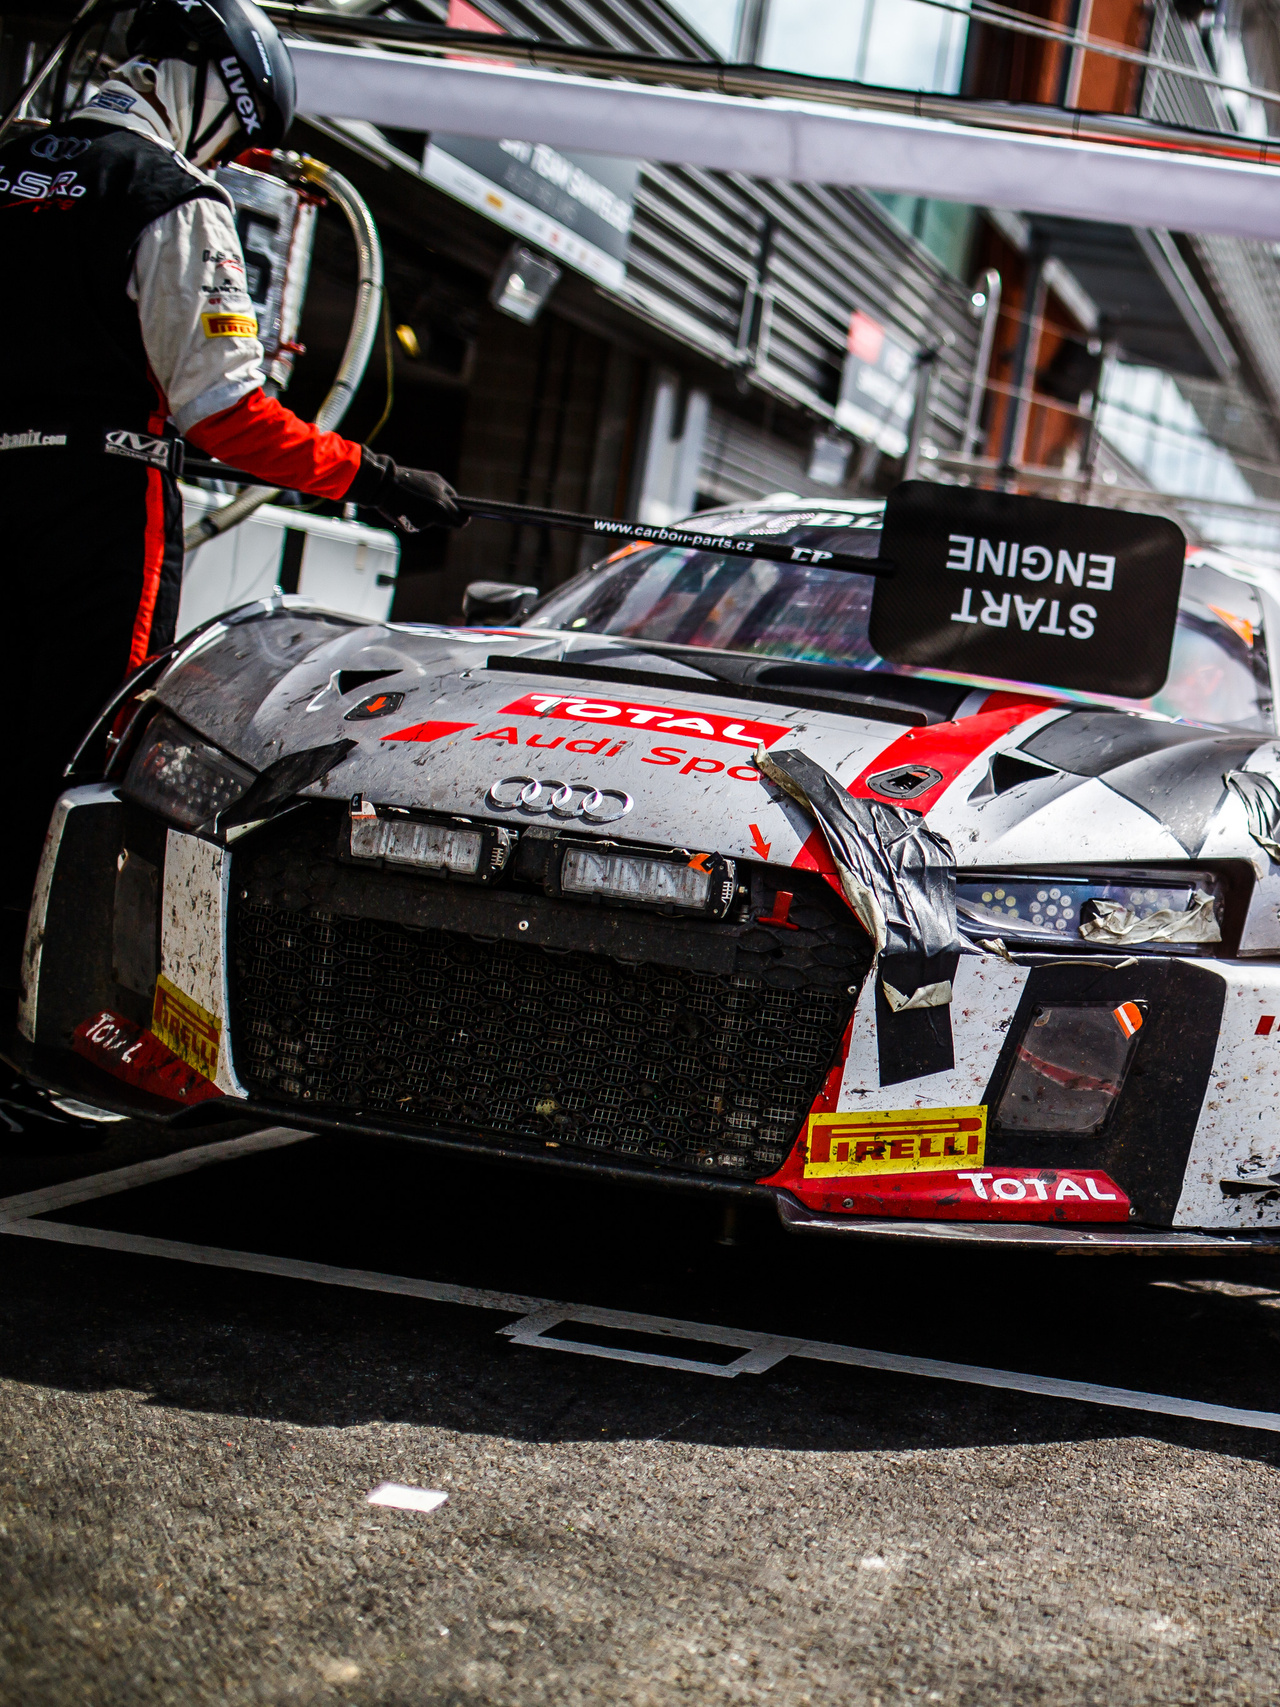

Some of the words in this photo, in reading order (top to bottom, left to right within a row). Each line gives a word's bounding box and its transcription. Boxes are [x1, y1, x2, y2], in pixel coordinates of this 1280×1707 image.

[219, 56, 262, 135] uvex
[593, 519, 755, 552] www.carbon-parts.cz
[946, 534, 1116, 591] ENGINE
[950, 587, 1098, 640] START
[530, 694, 764, 744] TOTAL
[472, 726, 628, 758] Audi
[641, 746, 765, 782] Spo
[154, 993, 220, 1066] PIRELLI
[810, 1117, 983, 1163] PIRELLI
[957, 1172, 1117, 1201] TOTAL
